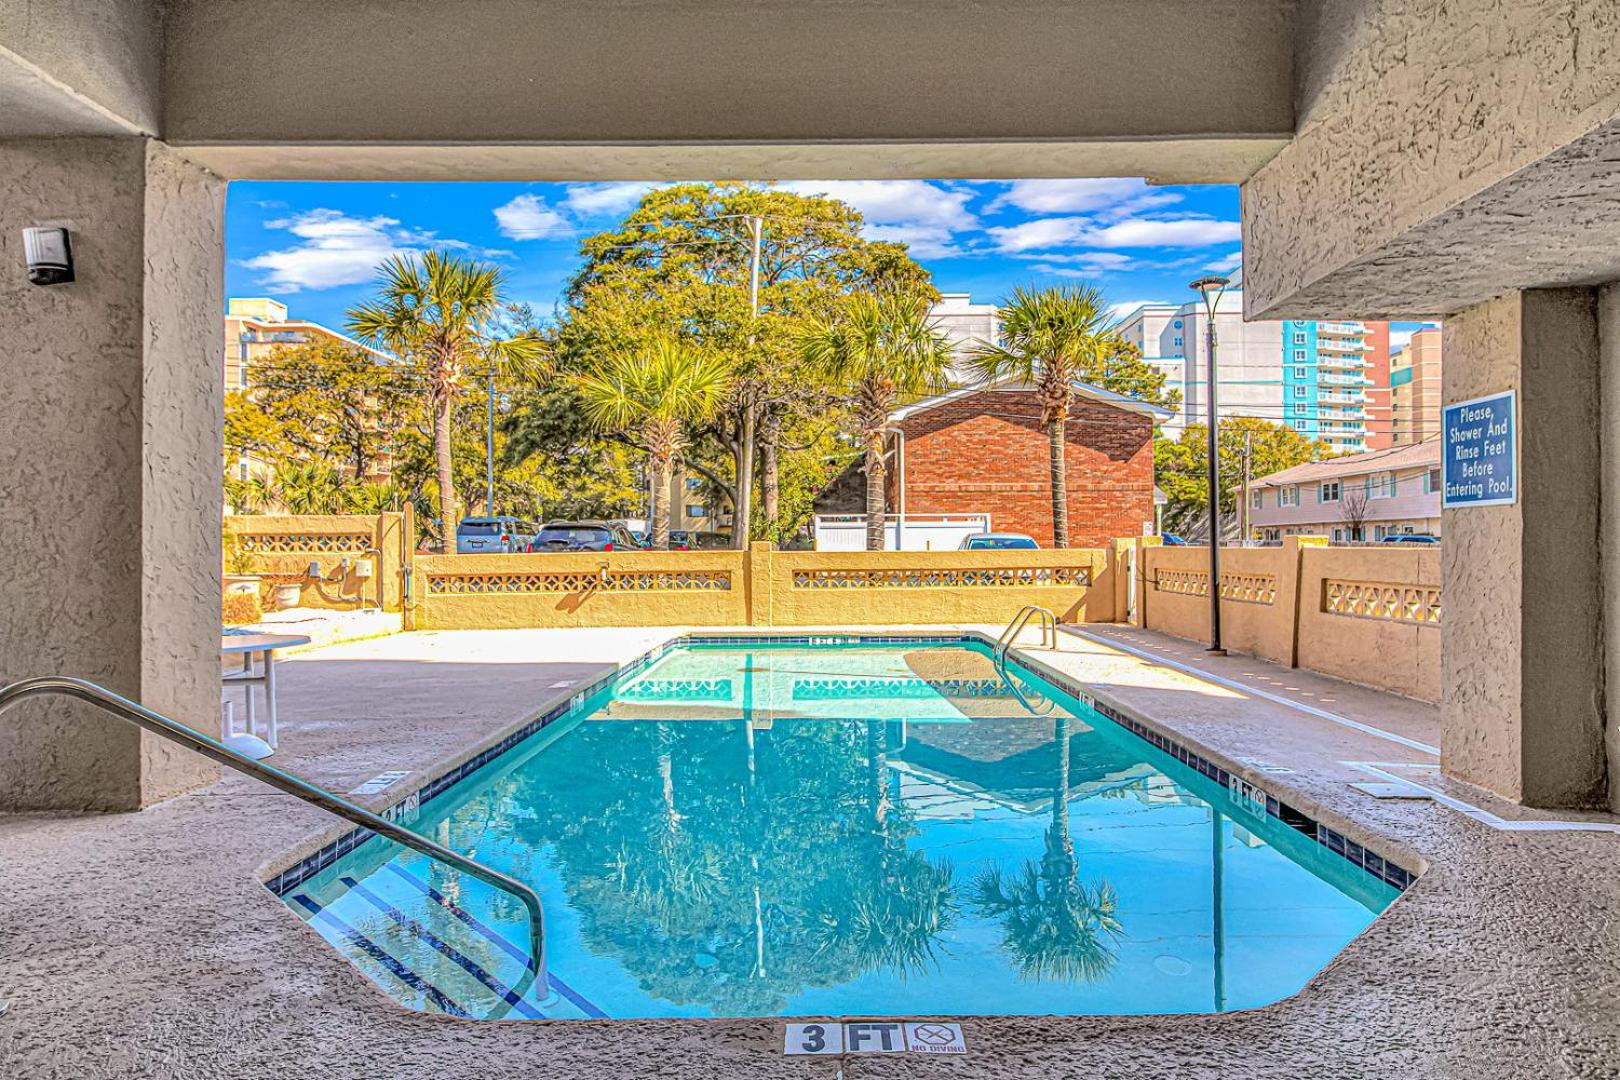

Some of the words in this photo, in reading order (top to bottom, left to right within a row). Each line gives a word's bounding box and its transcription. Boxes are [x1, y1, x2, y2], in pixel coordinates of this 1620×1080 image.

[1460, 407, 1494, 423] Please,
[1450, 427, 1482, 443] Shower
[1487, 418, 1508, 437] And
[1456, 446, 1479, 460] Rinse
[1484, 440, 1506, 456] Feet
[1463, 461, 1493, 477] Before
[1446, 482, 1483, 498] Entering
[1488, 476, 1513, 493] Pool.
[802, 1024, 826, 1053] 3
[848, 1024, 899, 1051] FT
